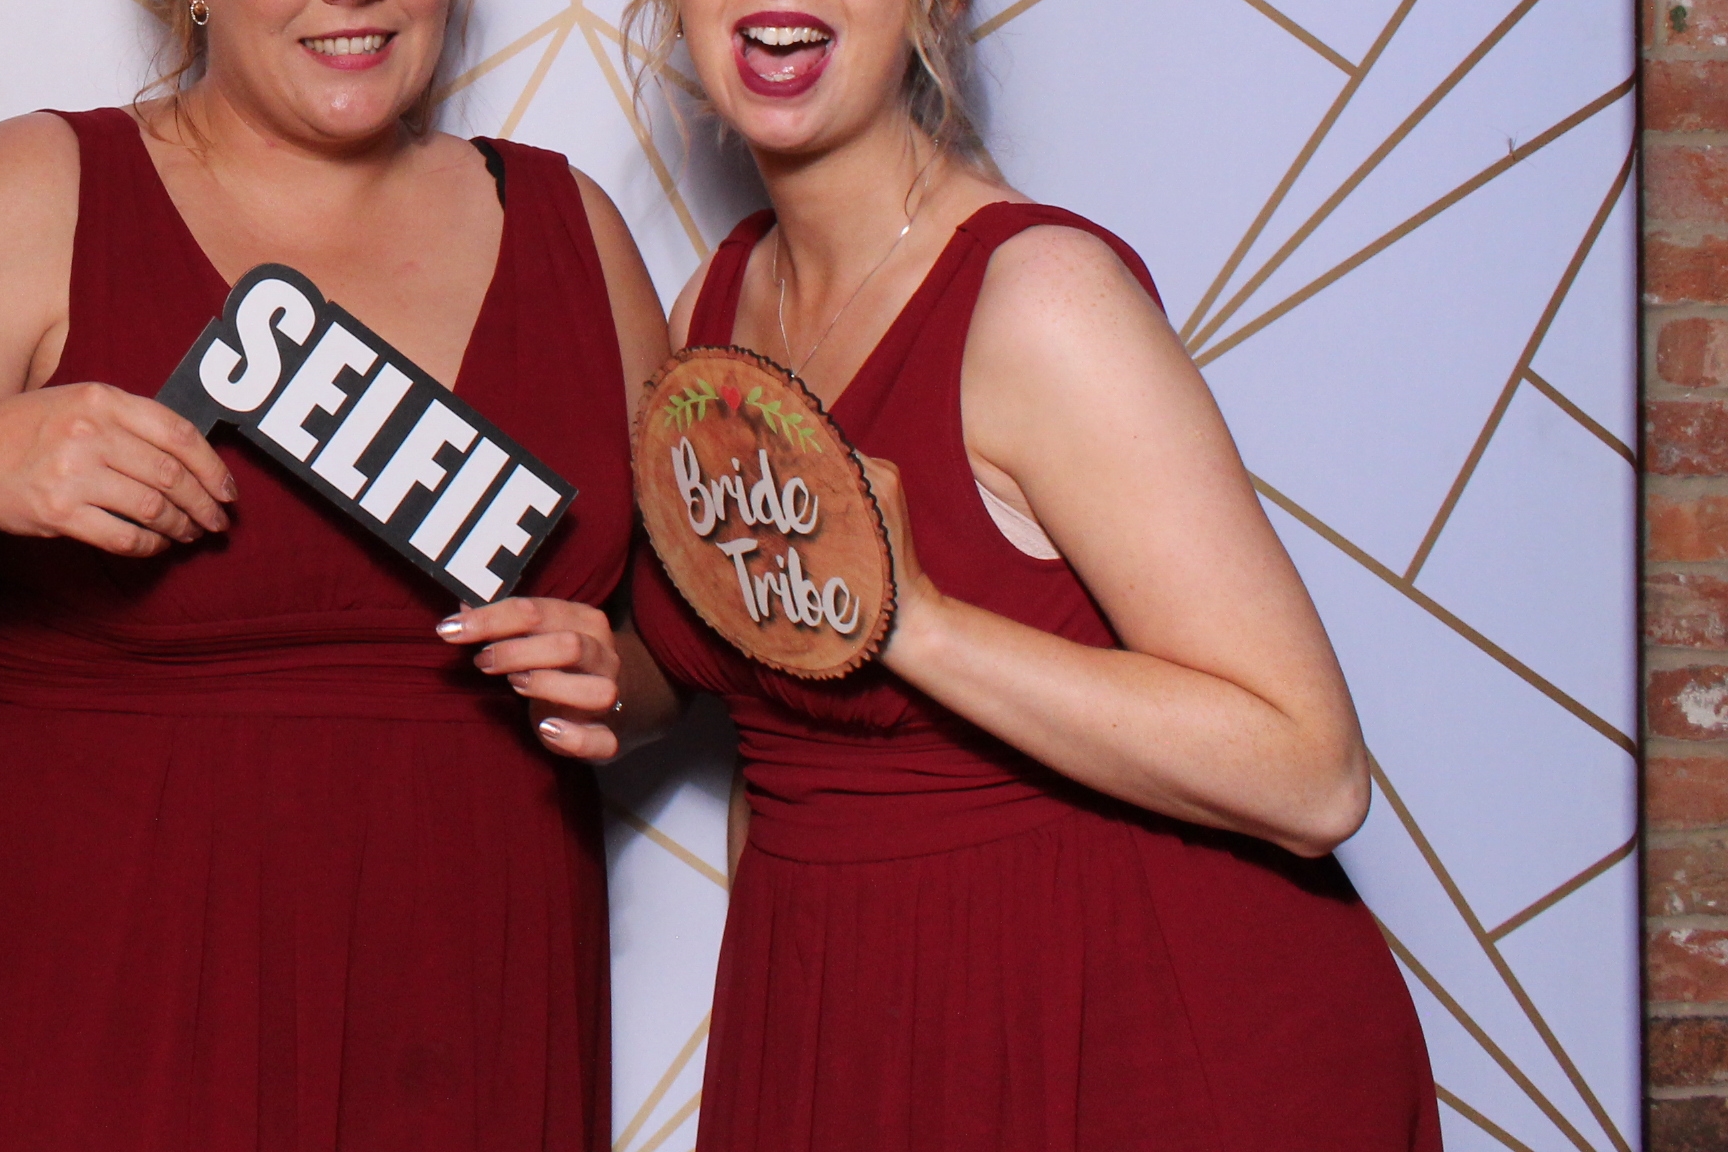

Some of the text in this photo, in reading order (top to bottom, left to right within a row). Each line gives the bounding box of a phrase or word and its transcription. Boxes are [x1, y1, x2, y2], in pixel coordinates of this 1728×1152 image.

[198, 278, 562, 603] SELFIE
[670, 435, 819, 537] Bride
[715, 537, 860, 634] Tribe
